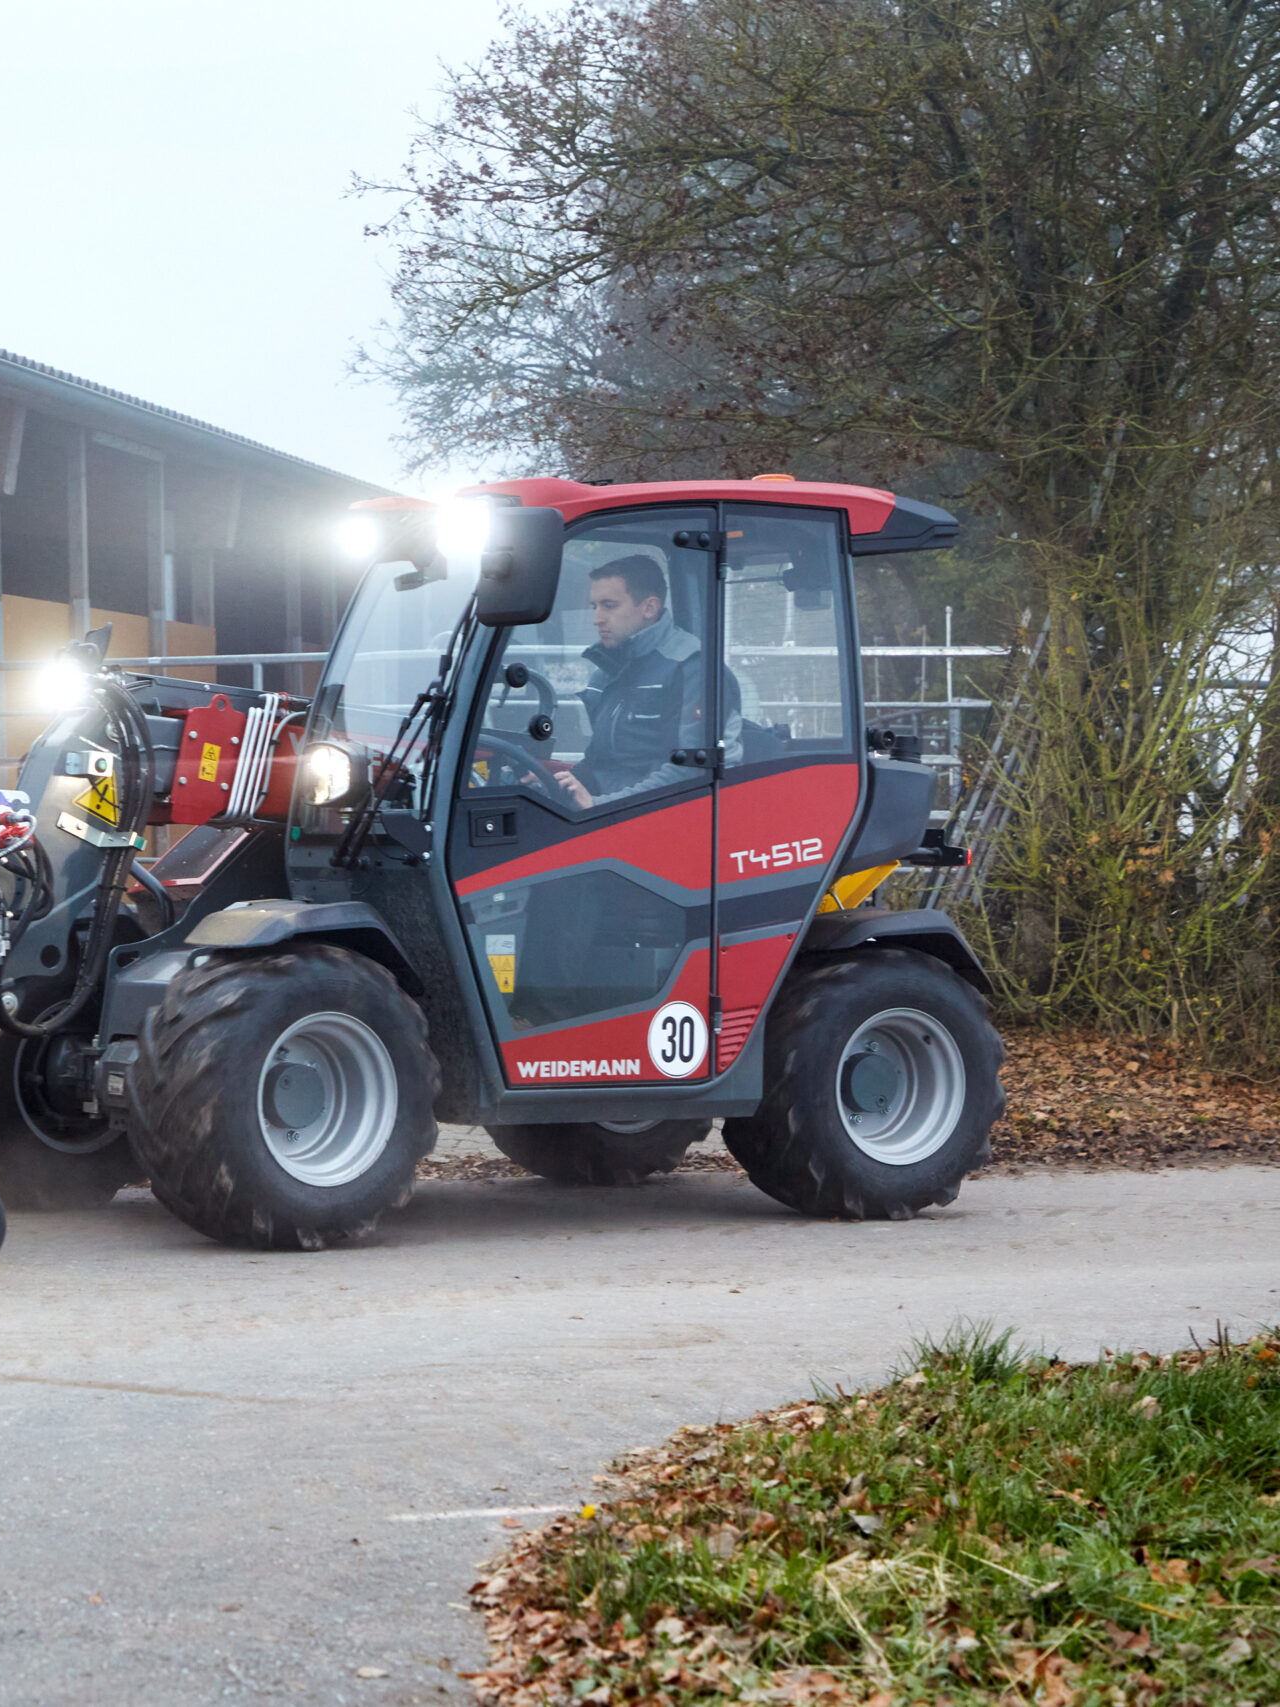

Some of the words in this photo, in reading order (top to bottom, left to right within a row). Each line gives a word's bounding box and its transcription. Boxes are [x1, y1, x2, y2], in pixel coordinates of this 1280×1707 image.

[729, 838, 824, 873] T4512
[661, 1016, 694, 1063] 30
[517, 1059, 640, 1078] WEIDEMANN
